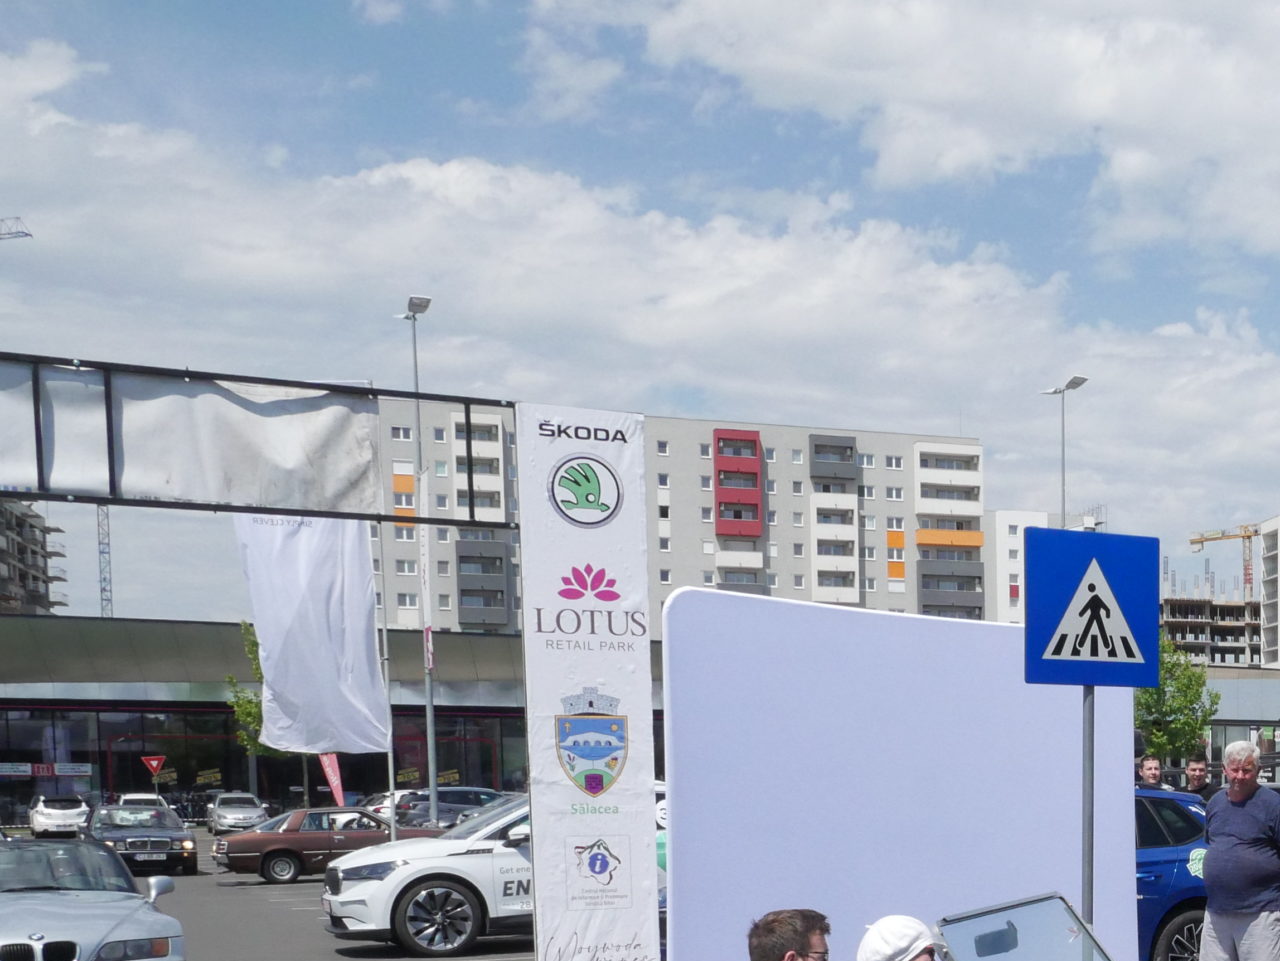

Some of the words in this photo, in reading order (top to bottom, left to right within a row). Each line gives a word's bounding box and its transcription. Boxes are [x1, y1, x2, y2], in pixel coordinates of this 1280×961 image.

[538, 419, 628, 443] ŠKODA
[533, 607, 647, 637] LOTUS
[545, 639, 595, 651] RETAIL
[599, 641, 636, 652] PARK
[570, 803, 619, 815] Sălacea
